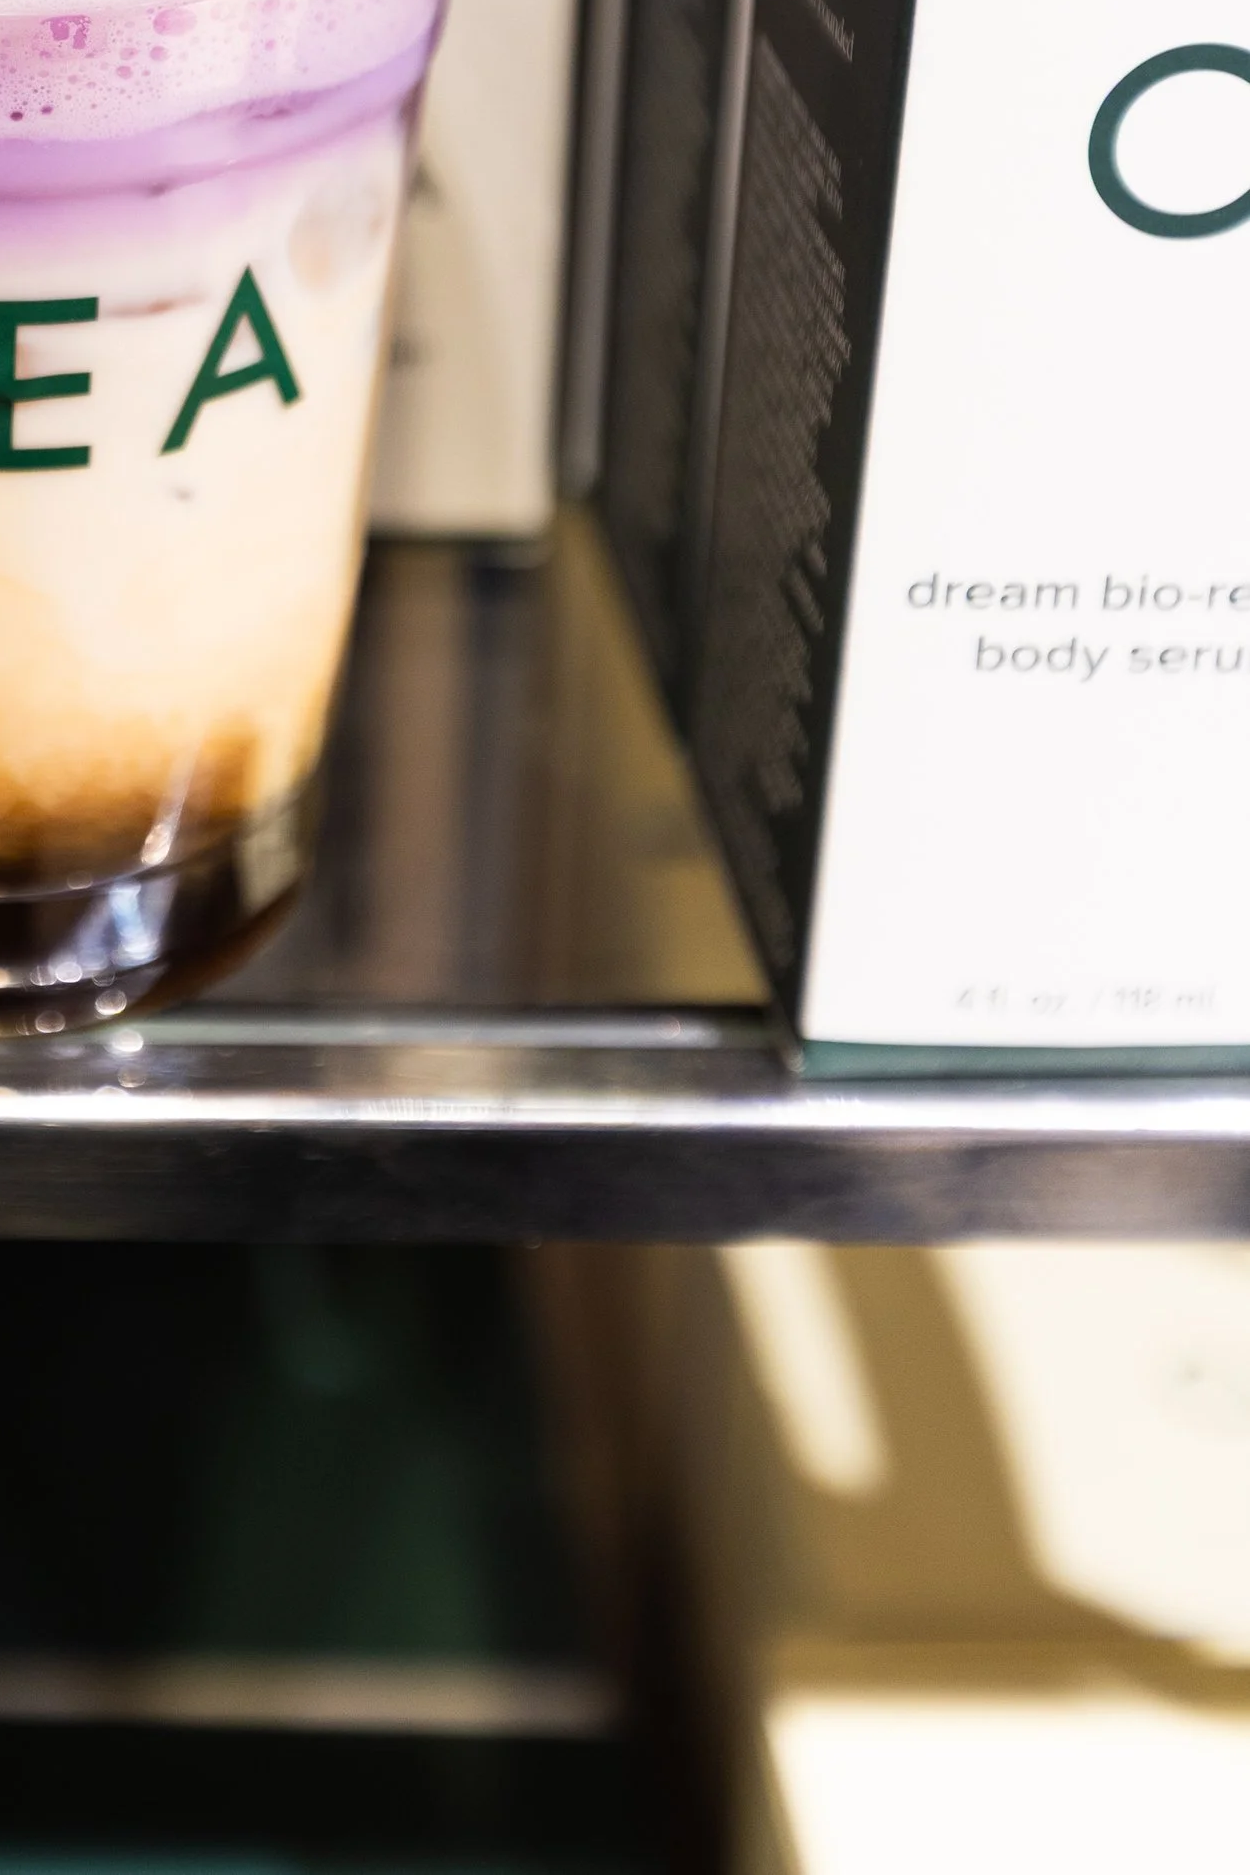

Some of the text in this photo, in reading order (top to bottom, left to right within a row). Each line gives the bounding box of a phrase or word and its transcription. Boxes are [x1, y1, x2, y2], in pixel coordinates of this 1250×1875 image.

[905, 570, 1080, 610] dream
[974, 633, 1250, 682] body seru
